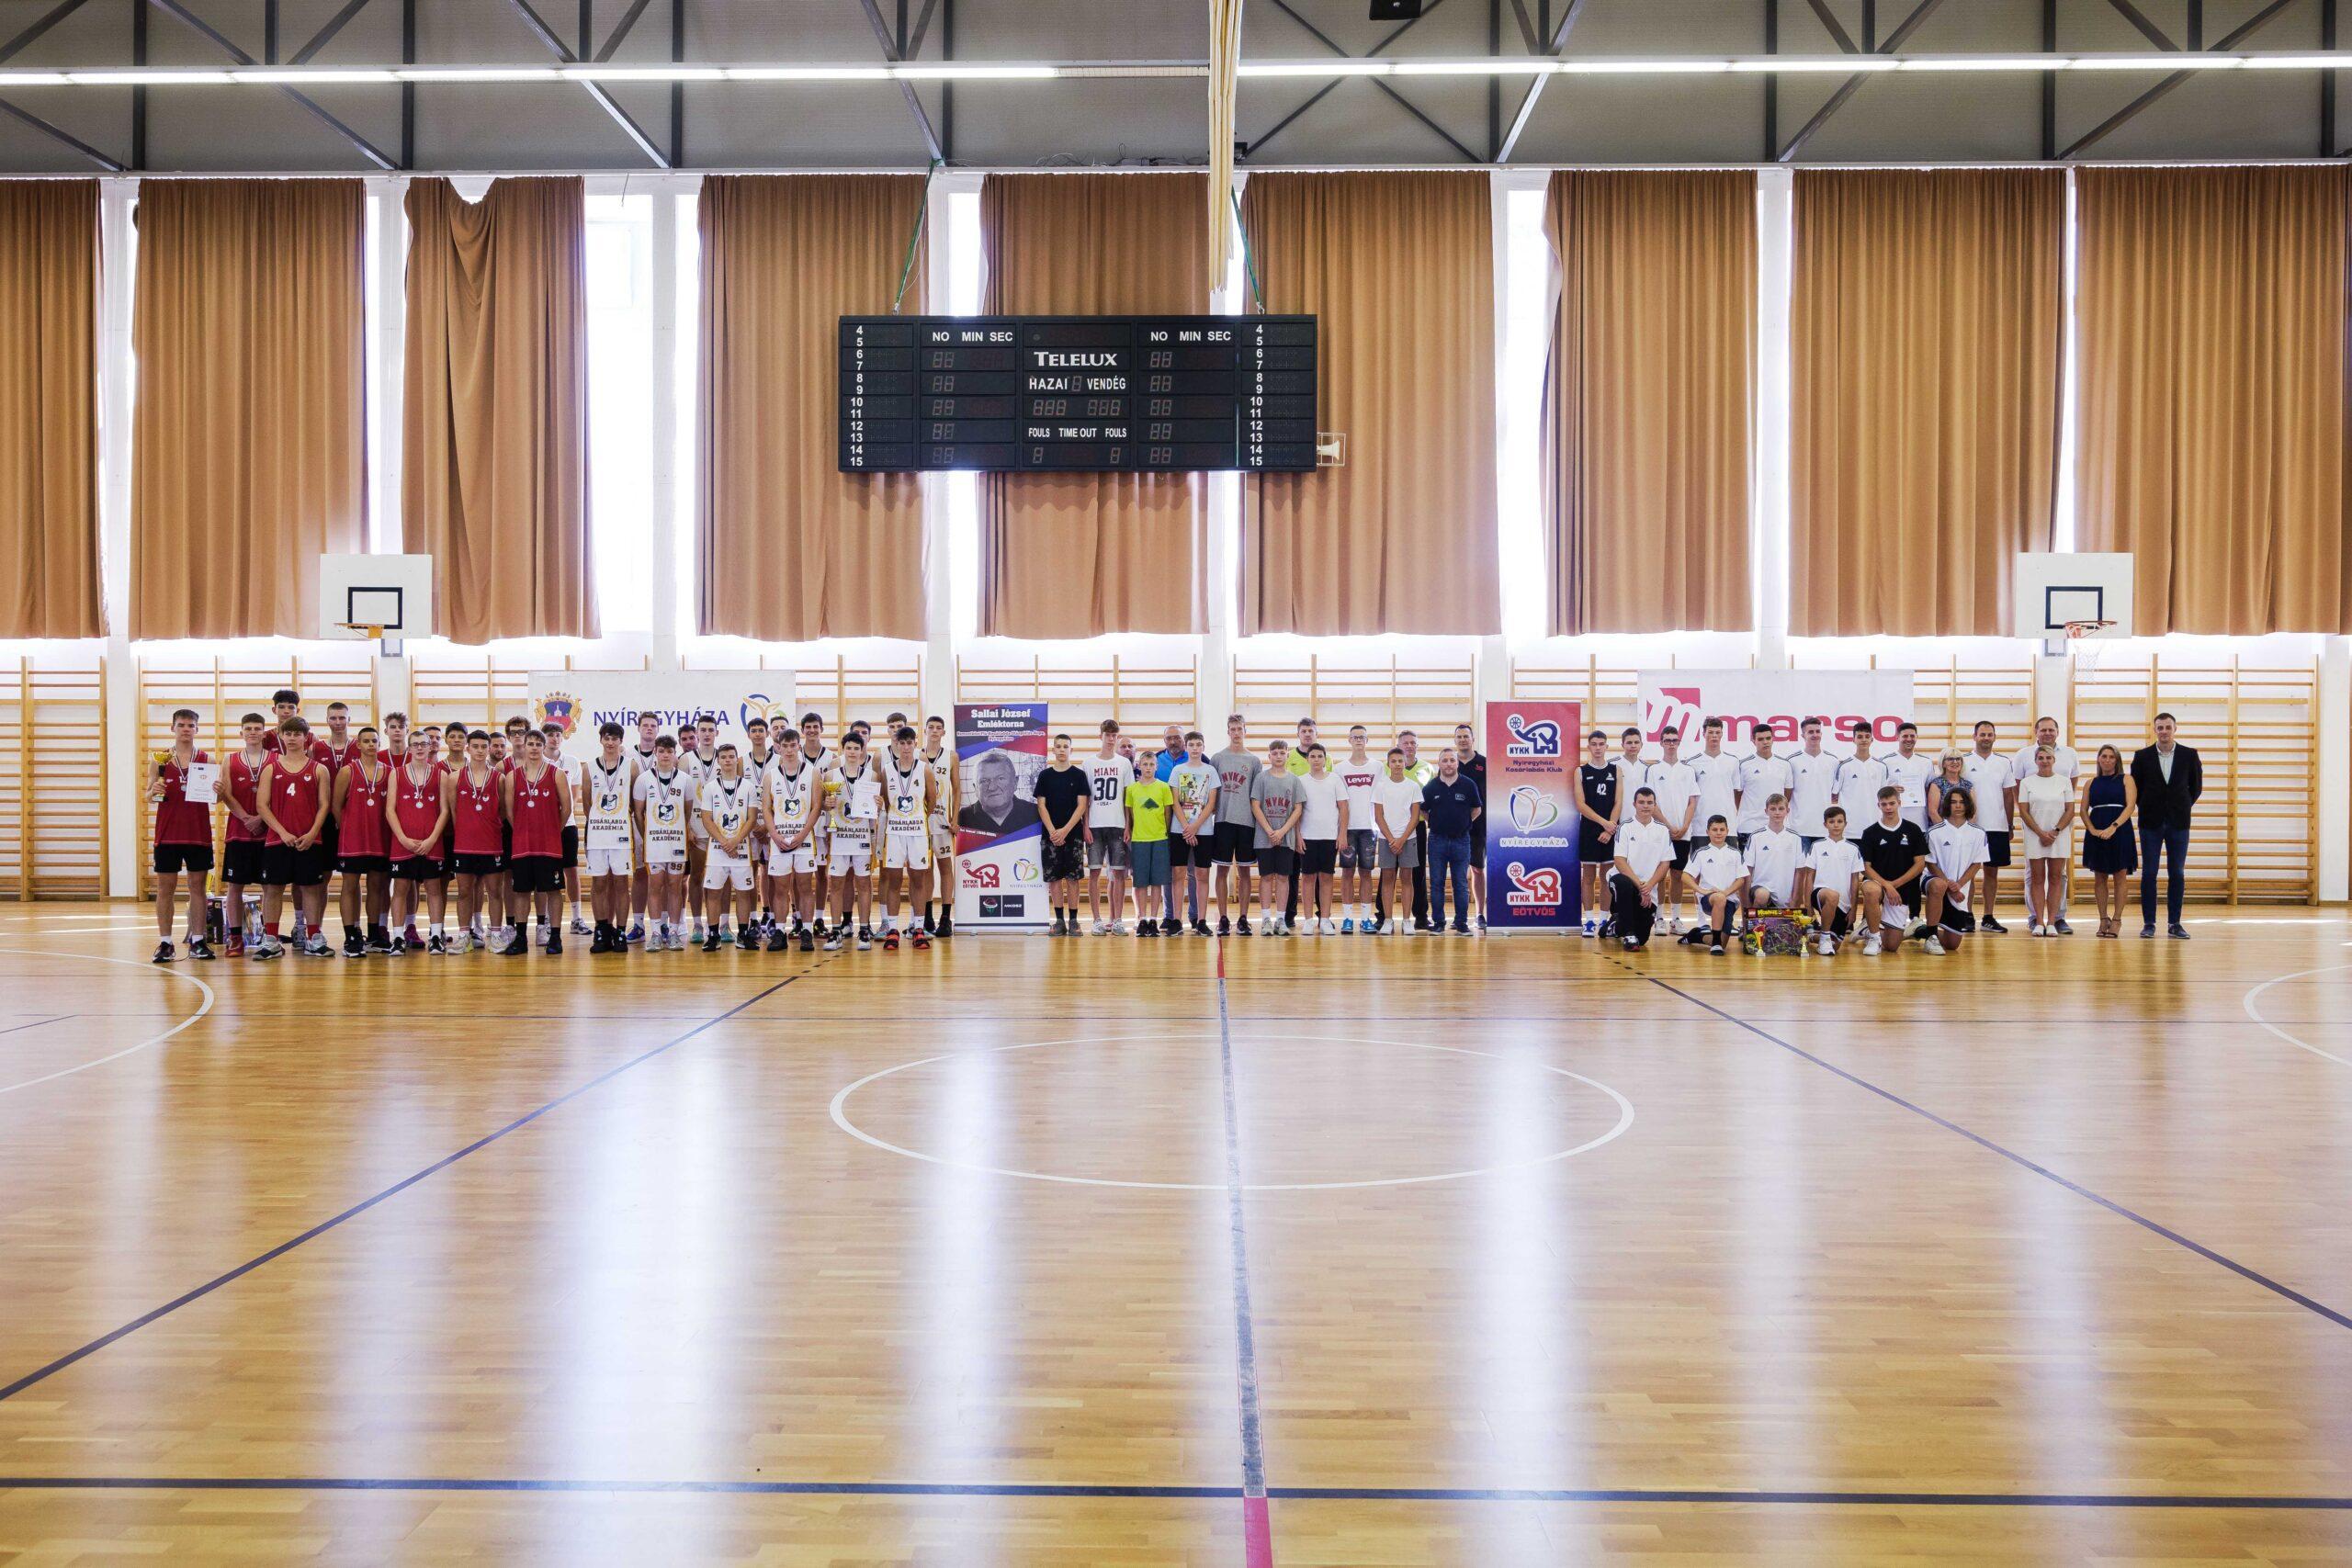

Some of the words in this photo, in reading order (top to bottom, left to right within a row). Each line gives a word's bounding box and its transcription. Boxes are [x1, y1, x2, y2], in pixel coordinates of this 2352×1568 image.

[855, 325, 863, 334] 4
[1255, 324, 1263, 333] 4
[856, 337, 863, 346] 5
[933, 332, 950, 342] NO
[961, 332, 984, 342] MIN
[989, 332, 1013, 342] SEC
[1150, 332, 1169, 342] NO
[1180, 332, 1202, 342] MIN
[1207, 332, 1231, 342] SEC
[1256, 336, 1263, 345] 5
[856, 349, 863, 358] 6
[1256, 348, 1263, 357] 6
[1033, 351, 1118, 367] TELELUX
[856, 361, 863, 370] 7
[1256, 360, 1263, 369] 7
[856, 373, 863, 382] 8
[1256, 372, 1263, 382] 8
[1029, 378, 1068, 390] HAZAI
[1087, 375, 1126, 390] VENDÉG
[856, 385, 863, 394] 9
[1256, 384, 1263, 394] 9
[851, 397, 863, 406] 10
[1250, 396, 1263, 406] 10
[851, 409, 861, 418] 11
[1250, 409, 1261, 418] 11
[851, 421, 863, 430] 12
[1250, 421, 1263, 430] 12
[1028, 427, 1050, 438] FOULS
[1058, 427, 1079, 438] TIME
[1080, 427, 1098, 438] OUT
[1105, 427, 1127, 438] FOULS
[850, 433, 863, 442] 13
[1250, 433, 1263, 442] 13
[850, 445, 863, 454] 14
[1250, 445, 1263, 454] 14
[850, 457, 863, 466] 15
[1250, 457, 1263, 467] 15
[971, 709, 999, 718] Sallai
[1001, 708, 1031, 718] József
[977, 719, 1025, 728] Emléktorna
[1510, 746, 1530, 754] NYKK
[936, 766, 947, 775] 32
[1093, 767, 1118, 777] MIAMI
[913, 779, 920, 787] 4
[286, 783, 296, 796] 4
[670, 787, 682, 797] 99
[799, 784, 806, 792] 6
[1093, 776, 1118, 801] 30
[1596, 783, 1607, 795] 42
[738, 798, 744, 807] 5
[940, 845, 952, 854] 32
[808, 860, 815, 868] 6
[745, 877, 752, 886] 5
[1510, 895, 1531, 903] NYKK
